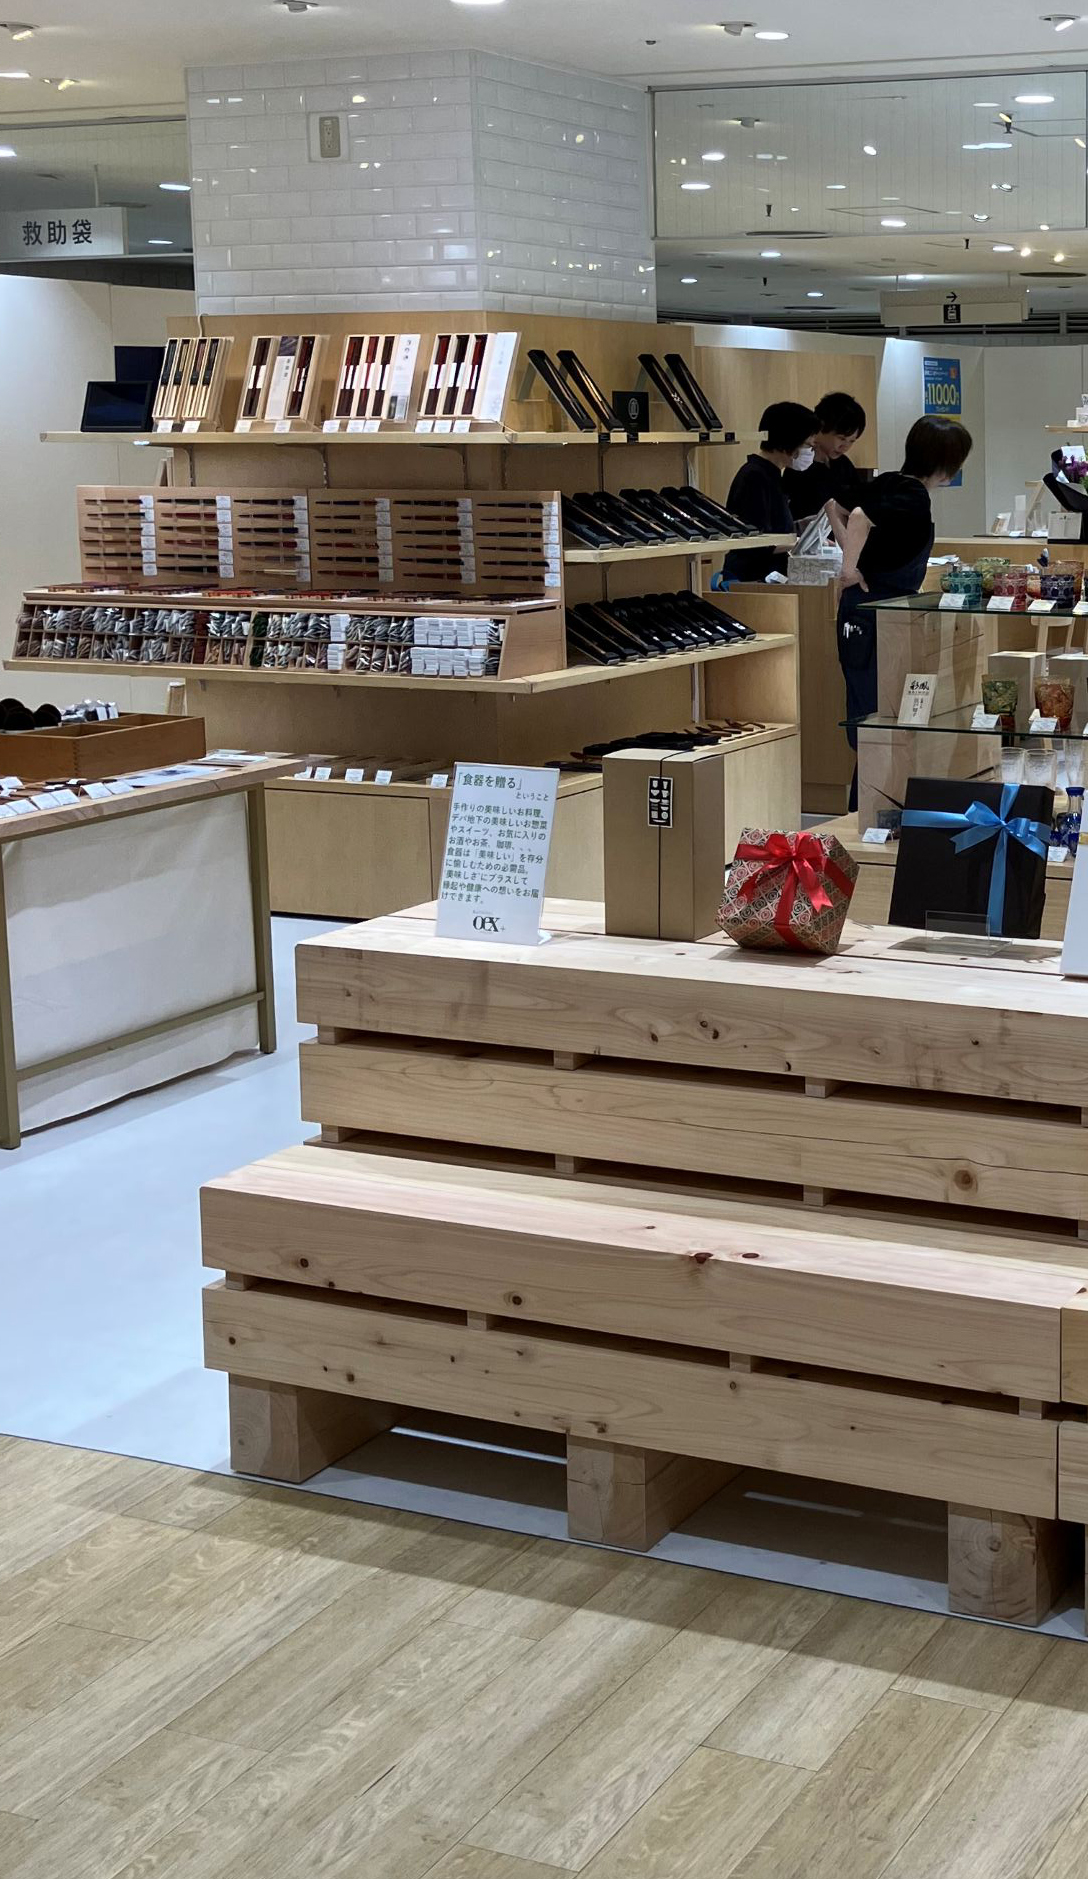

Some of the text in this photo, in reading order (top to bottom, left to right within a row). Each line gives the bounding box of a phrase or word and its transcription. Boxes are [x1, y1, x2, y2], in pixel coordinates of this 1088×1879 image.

[22, 219, 92, 246] 救助袋
[458, 772, 522, 791] 「食器を贈る」
[515, 792, 549, 802] ということ
[453, 803, 545, 818] 手作りの美味しいお料理、
[441, 892, 484, 905] けできます。
